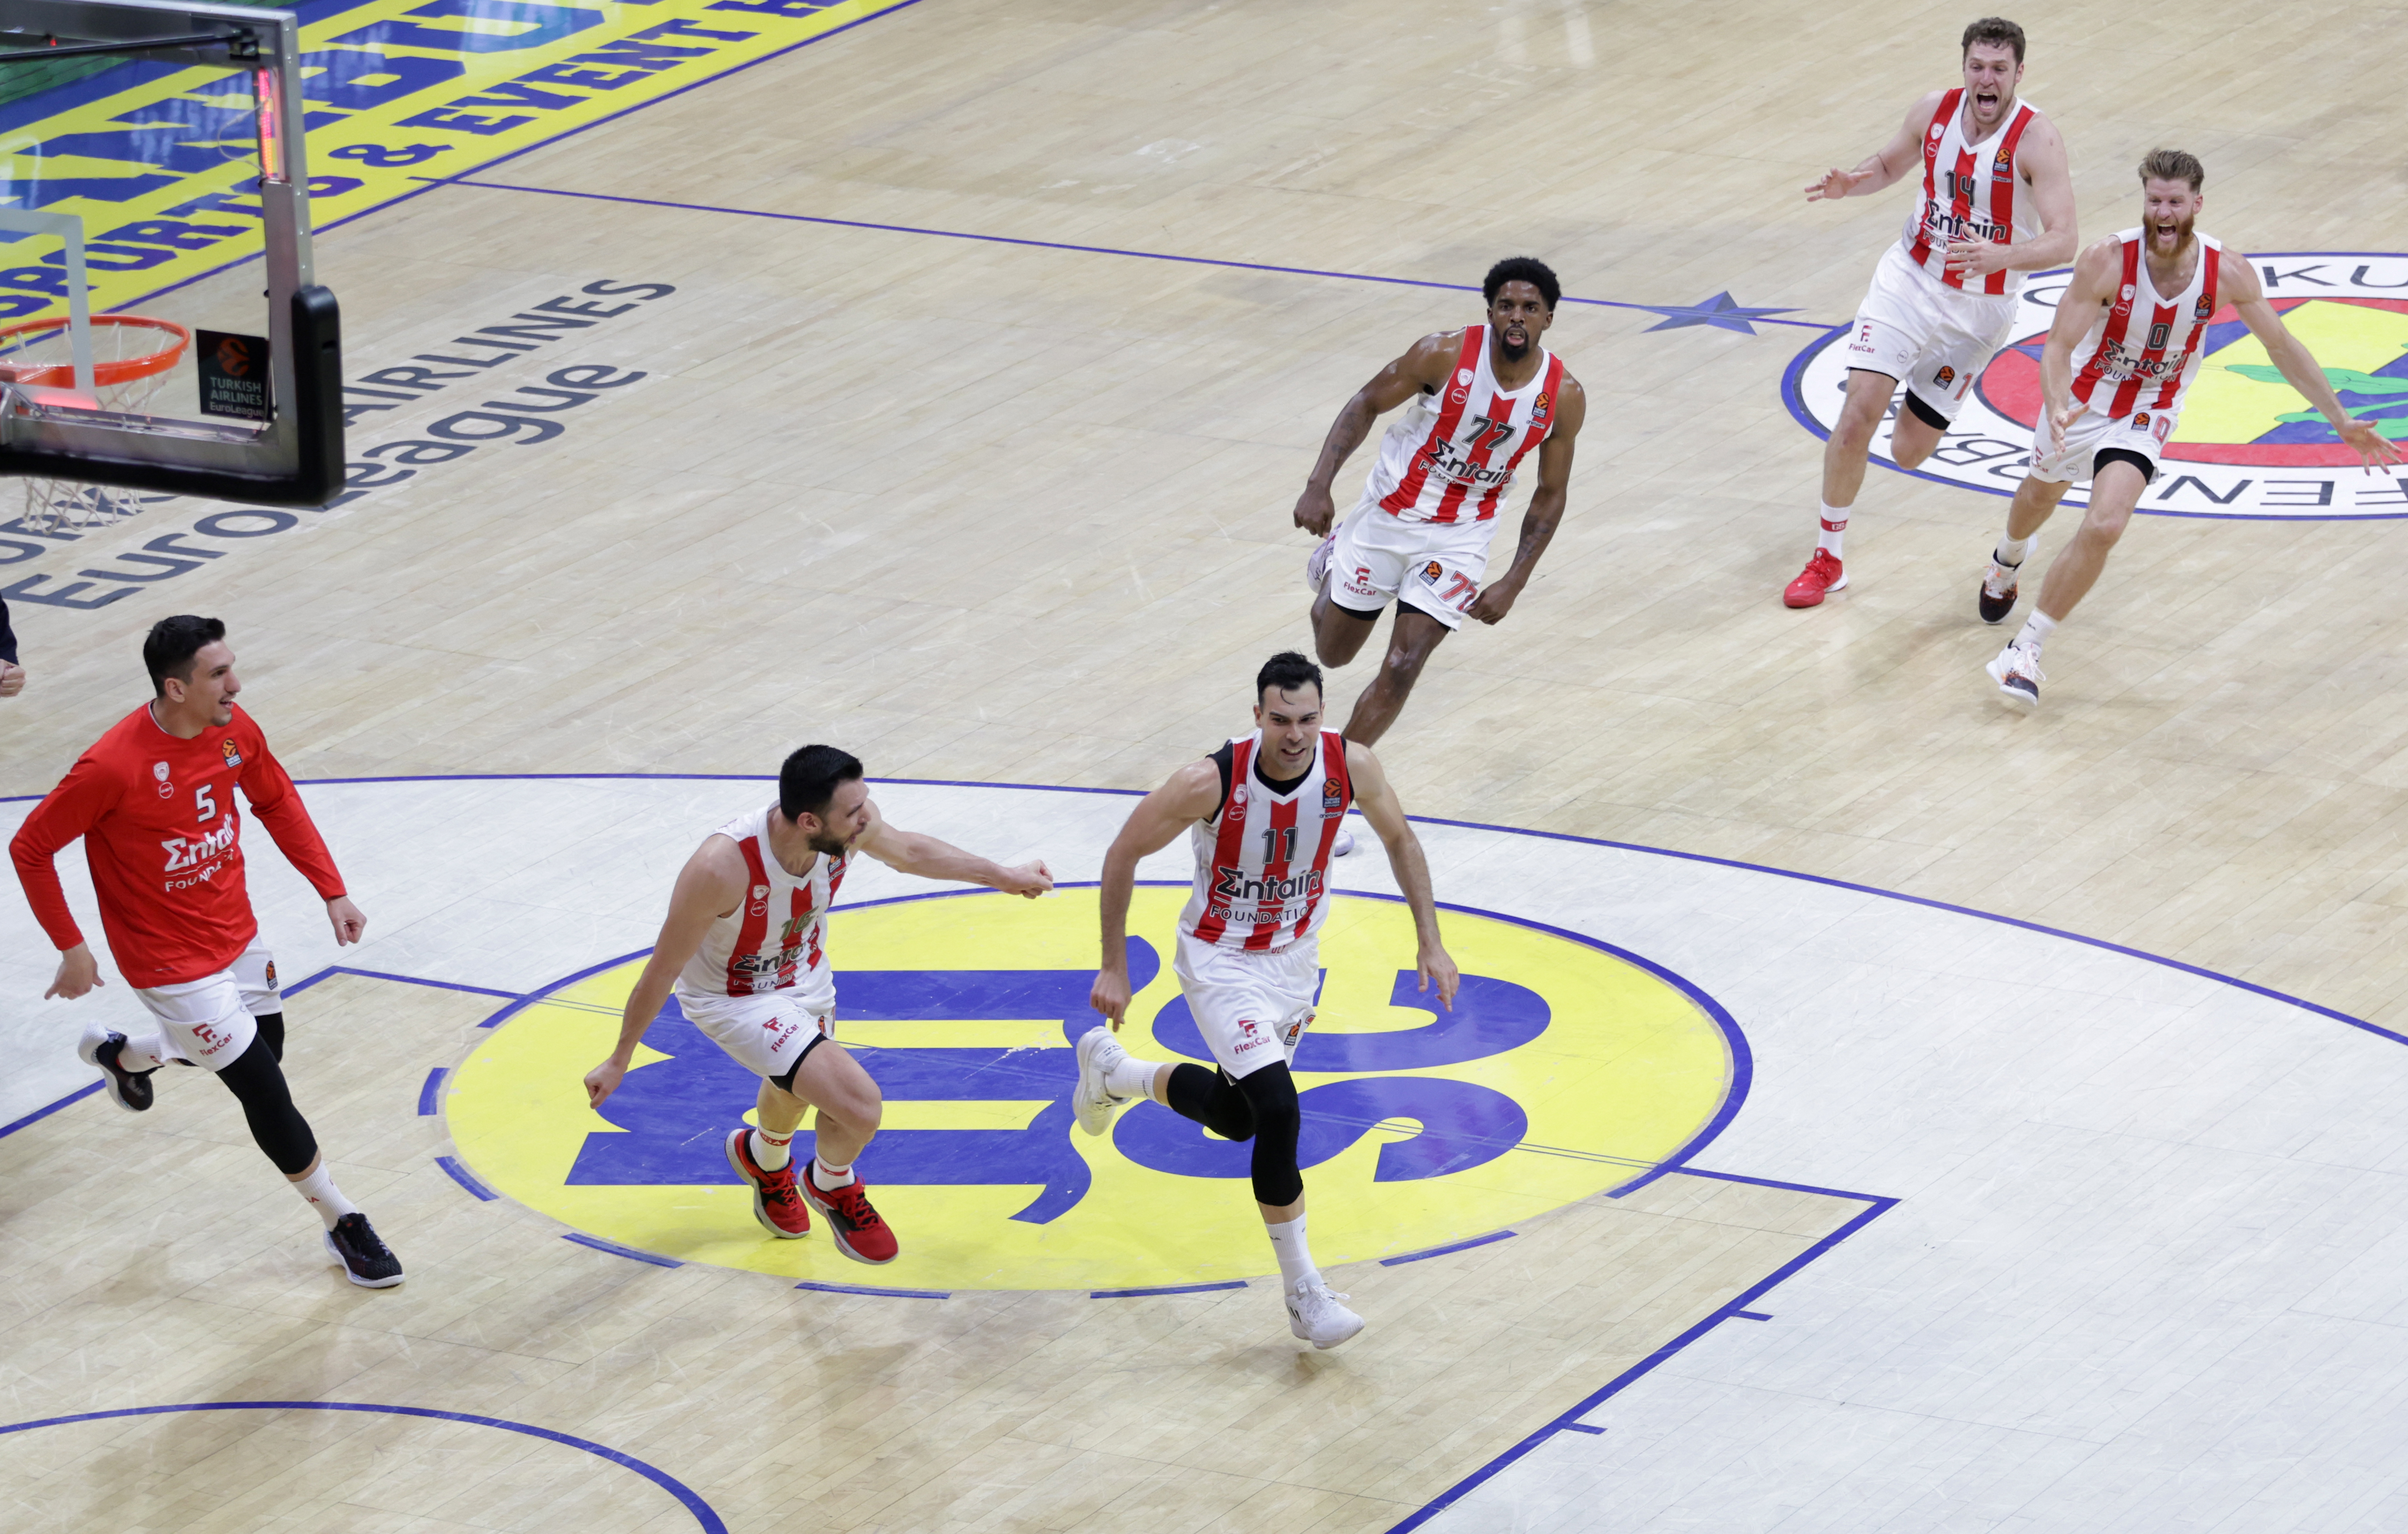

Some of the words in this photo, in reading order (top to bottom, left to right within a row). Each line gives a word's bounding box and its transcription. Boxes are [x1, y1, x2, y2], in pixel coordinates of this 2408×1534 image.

[390, 18, 763, 136] EVENT
[329, 144, 455, 168] &
[1945, 170, 1976, 208] 14
[1849, 343, 1876, 354] FlexCar
[2147, 323, 2171, 351] 0
[210, 376, 262, 393] TURKISH
[210, 389, 263, 406] AIRLINES
[209, 402, 265, 418] EuroLeague
[1462, 414, 1517, 450] 77
[2152, 415, 2171, 444] 0
[1344, 581, 1377, 596] FlexCar
[1438, 570, 1478, 612] 77
[195, 782, 216, 823] 5
[1261, 827, 1298, 865] 11
[779, 905, 819, 942] 16
[1209, 904, 1310, 924] FOUNDATIO
[199, 1031, 233, 1057] FlexCar
[770, 1023, 799, 1052] FlexCar
[1233, 1035, 1271, 1055] FlexCar
